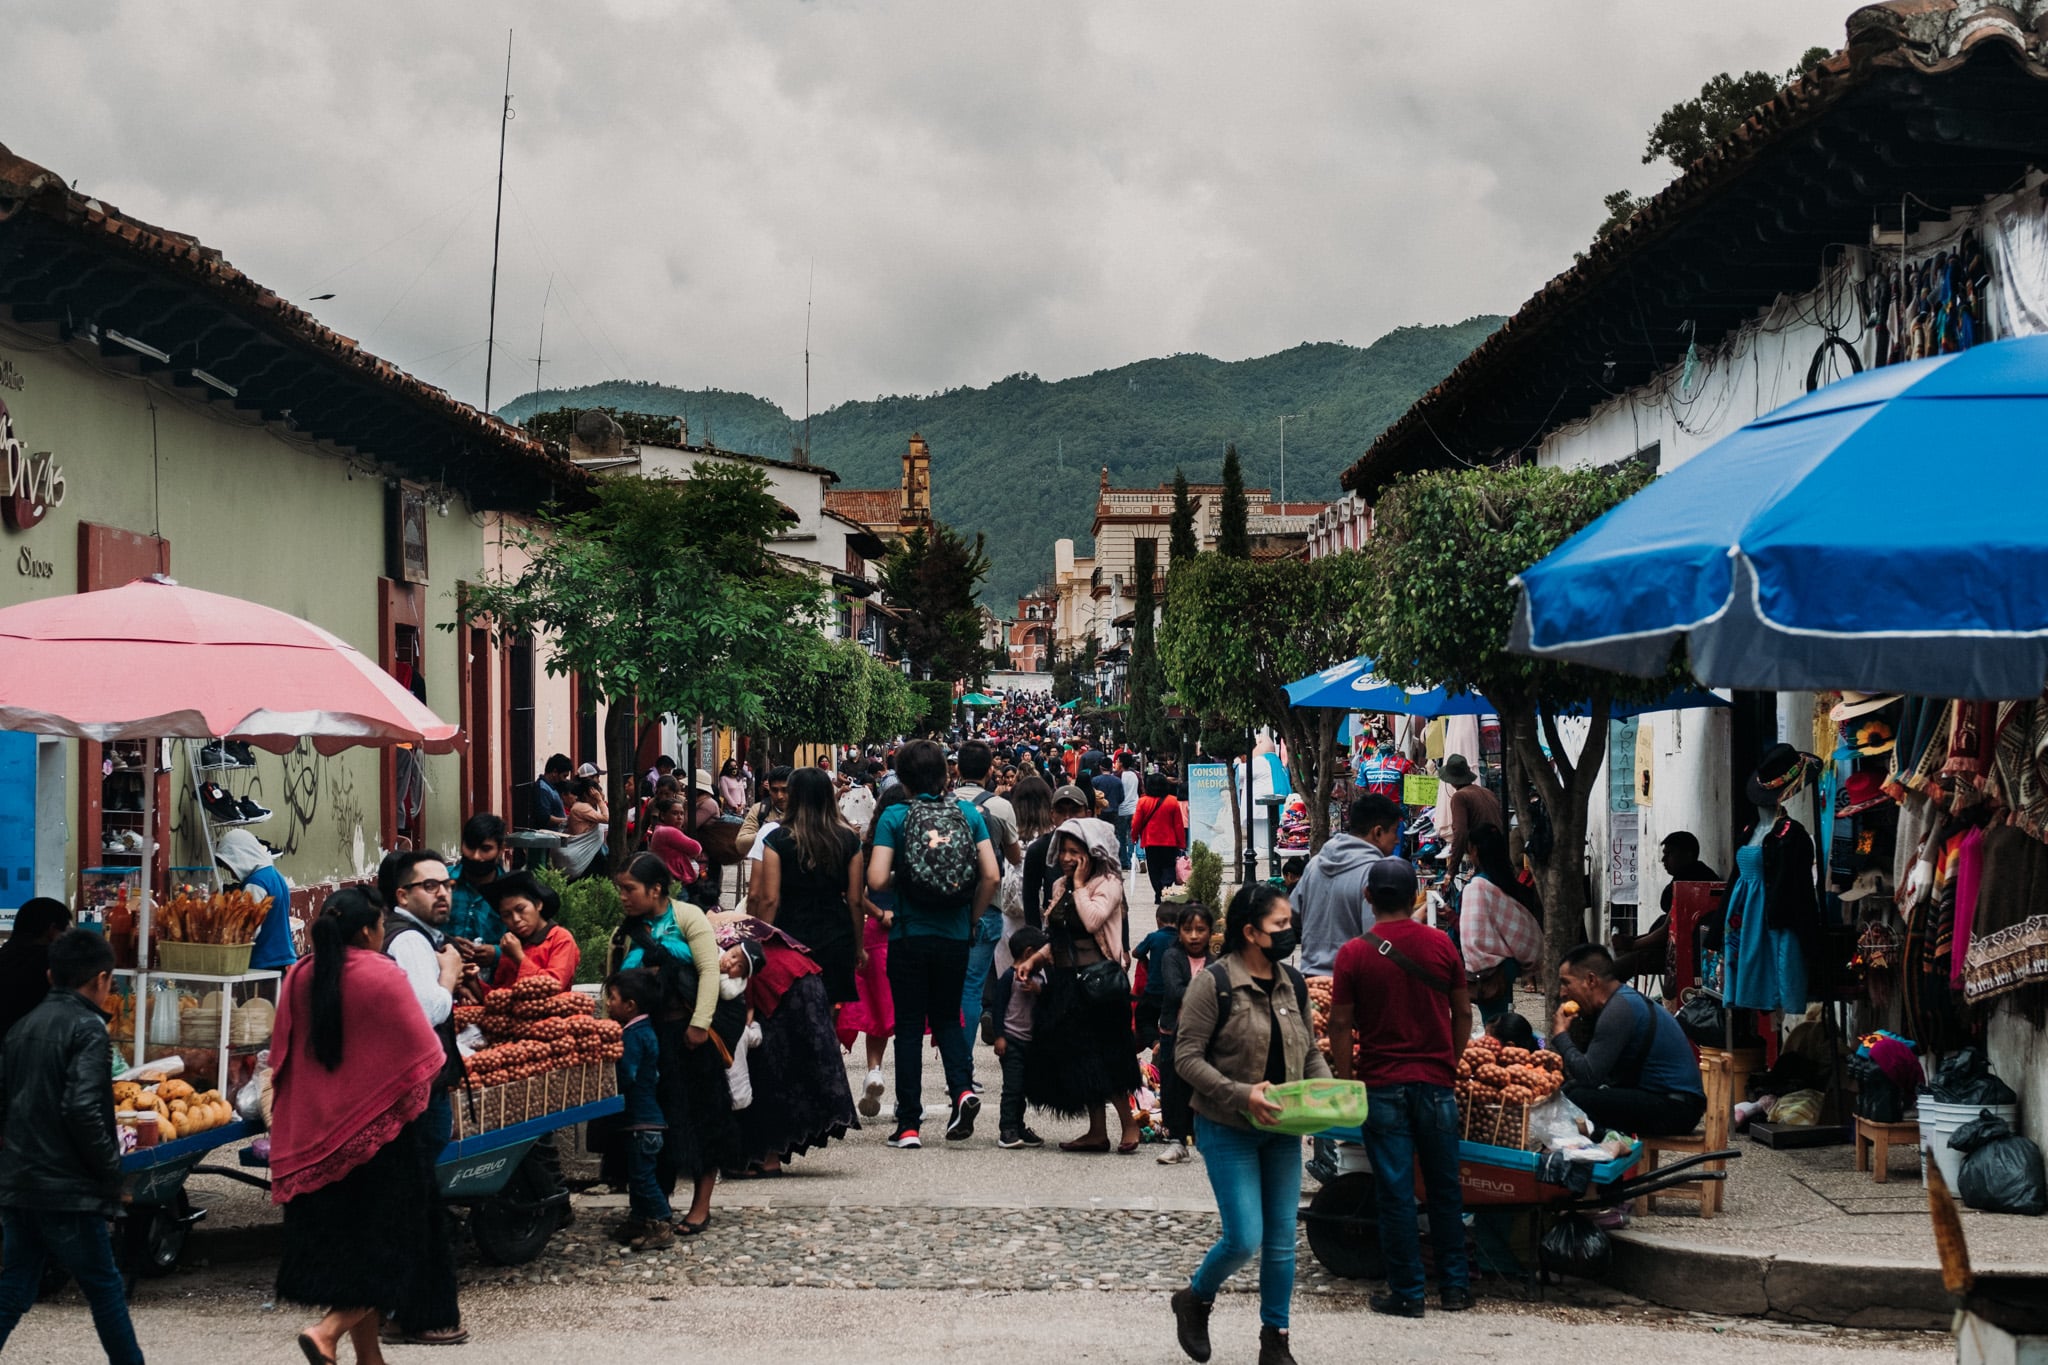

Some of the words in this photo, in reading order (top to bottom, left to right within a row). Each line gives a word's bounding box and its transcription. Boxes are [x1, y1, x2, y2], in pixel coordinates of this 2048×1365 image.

[17, 545, 53, 578] Shoes
[1192, 767, 1228, 777] CONSULT
[1612, 838, 1624, 886] USB
[1629, 845, 1637, 882] MICRO
[462, 1157, 507, 1179] CUERVO
